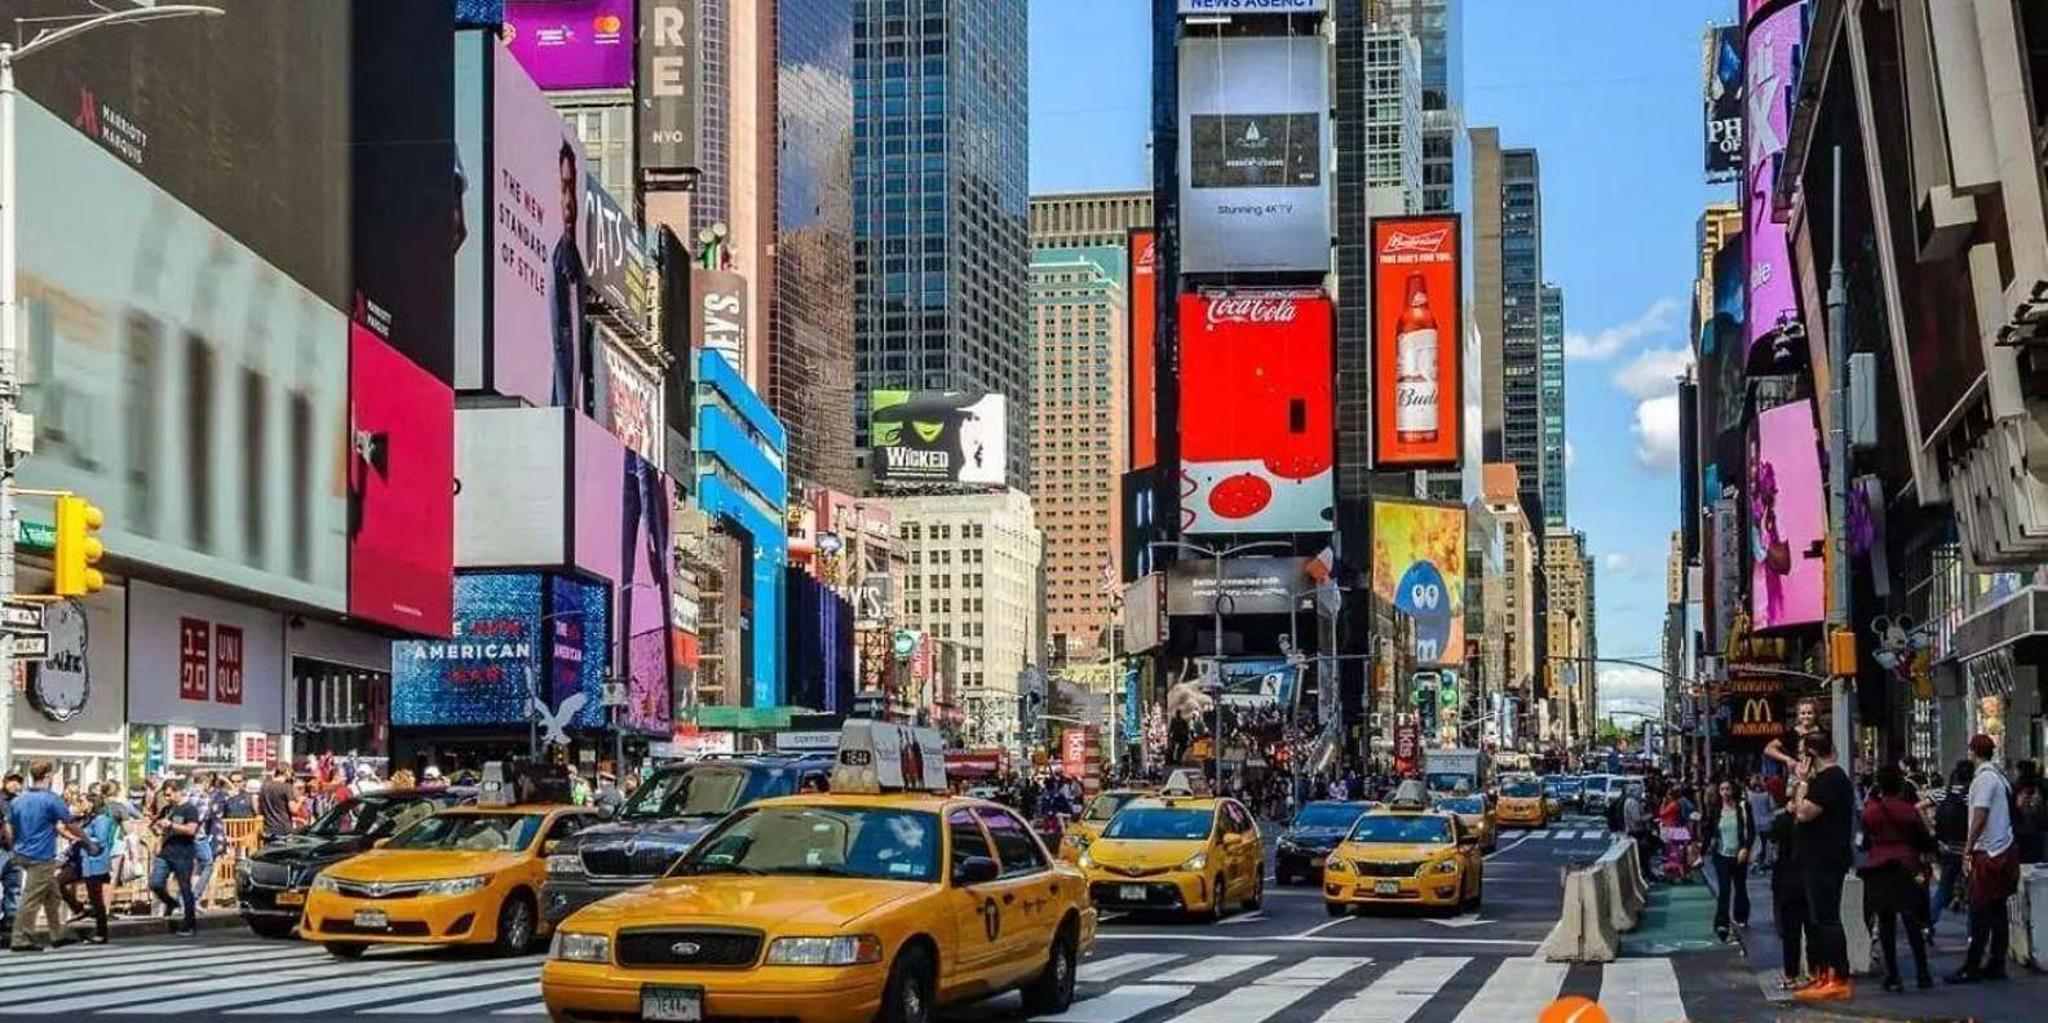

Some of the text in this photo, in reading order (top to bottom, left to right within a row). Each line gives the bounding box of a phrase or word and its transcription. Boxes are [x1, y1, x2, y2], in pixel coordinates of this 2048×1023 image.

[502, 168, 545, 227] THE NEW
[1218, 204, 1263, 215] Stunning
[499, 202, 549, 264] STANDARD
[585, 190, 624, 277] CATS
[502, 242, 545, 297] OF STYLE
[414, 643, 531, 660] AMERICAN
